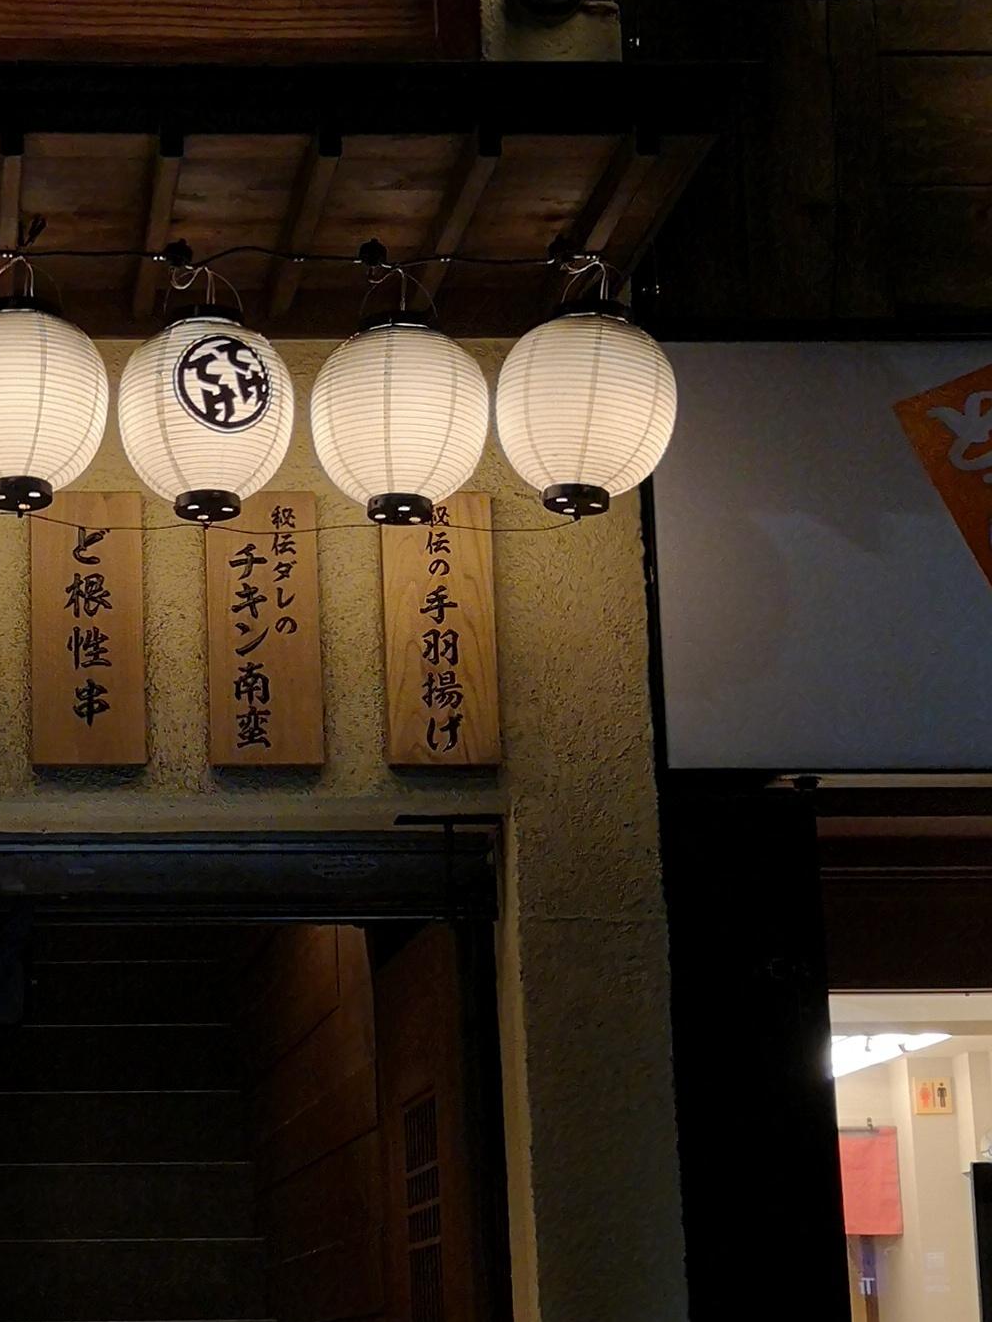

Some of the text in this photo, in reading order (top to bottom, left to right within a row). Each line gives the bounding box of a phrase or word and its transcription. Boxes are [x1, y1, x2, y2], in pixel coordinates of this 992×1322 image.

[63, 526, 113, 727] ど根性串
[228, 543, 272, 750] チキン南蛮
[270, 504, 298, 635] 秘伝ダレの
